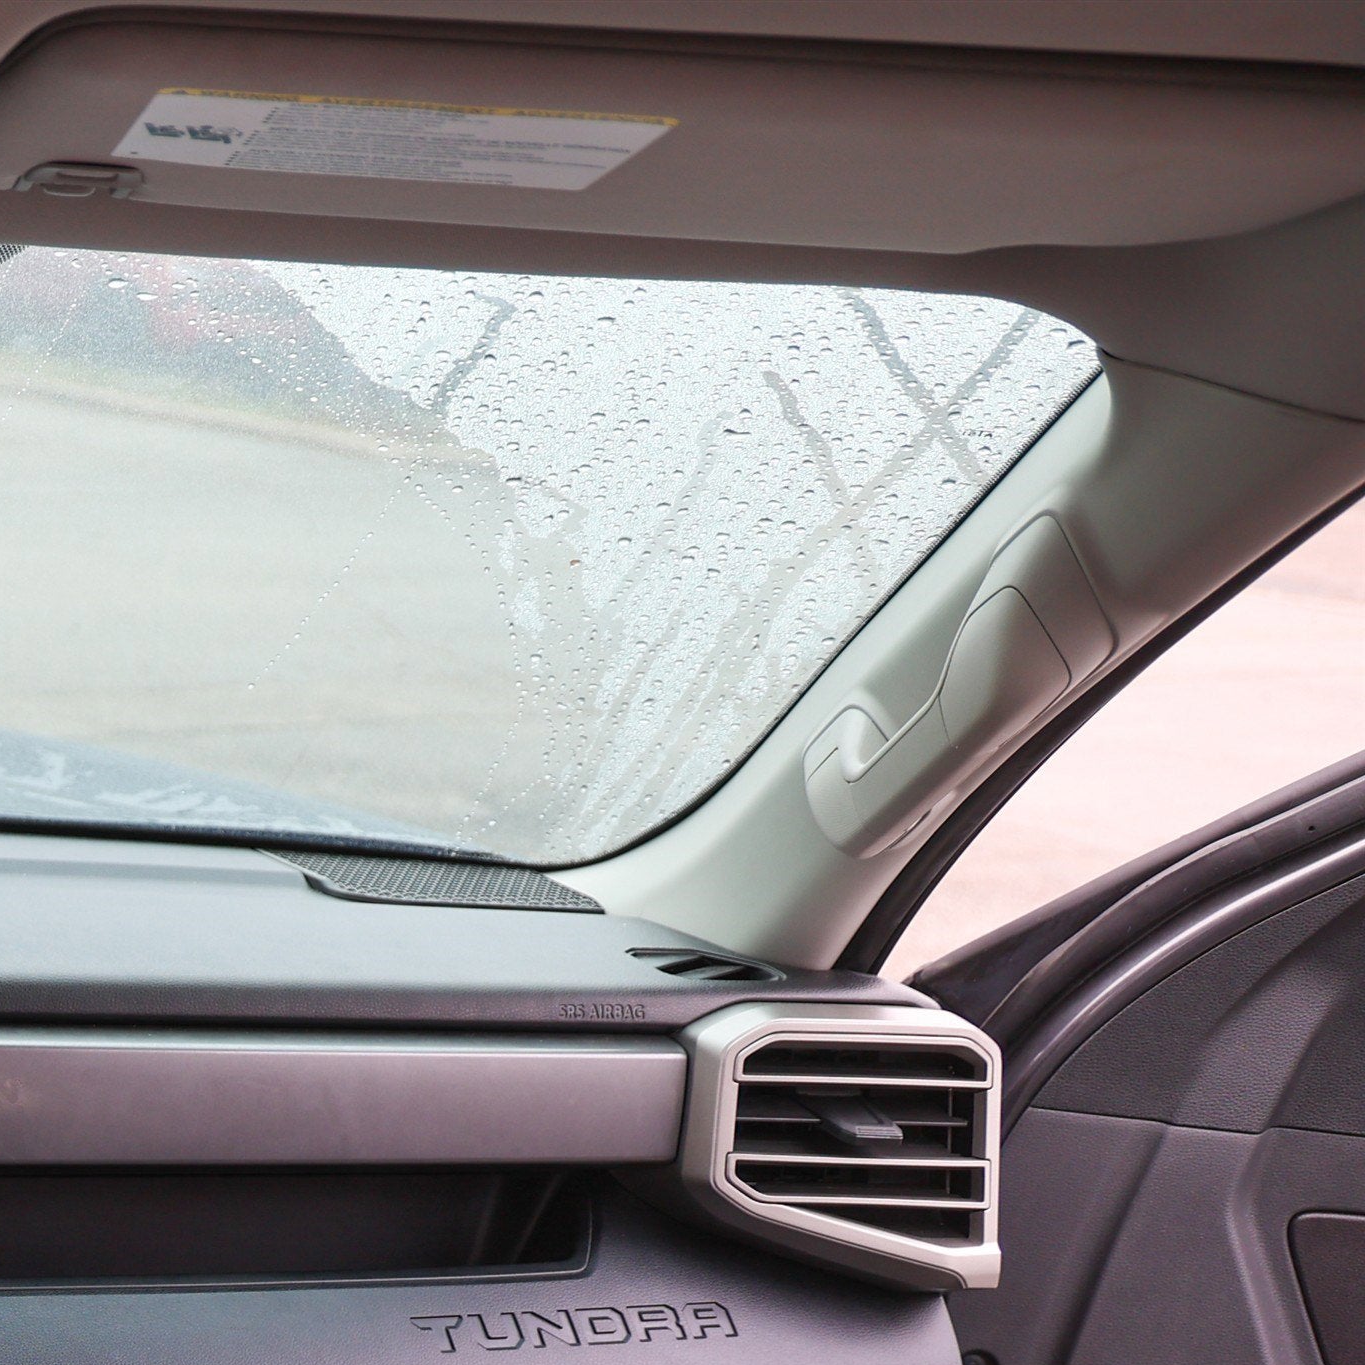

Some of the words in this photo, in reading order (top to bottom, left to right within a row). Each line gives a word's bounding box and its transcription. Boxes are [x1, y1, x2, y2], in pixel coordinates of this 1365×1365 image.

[559, 1004, 586, 1019] SRS
[590, 1004, 646, 1020] AIRBAG
[410, 1301, 739, 1353] TUNDRA
